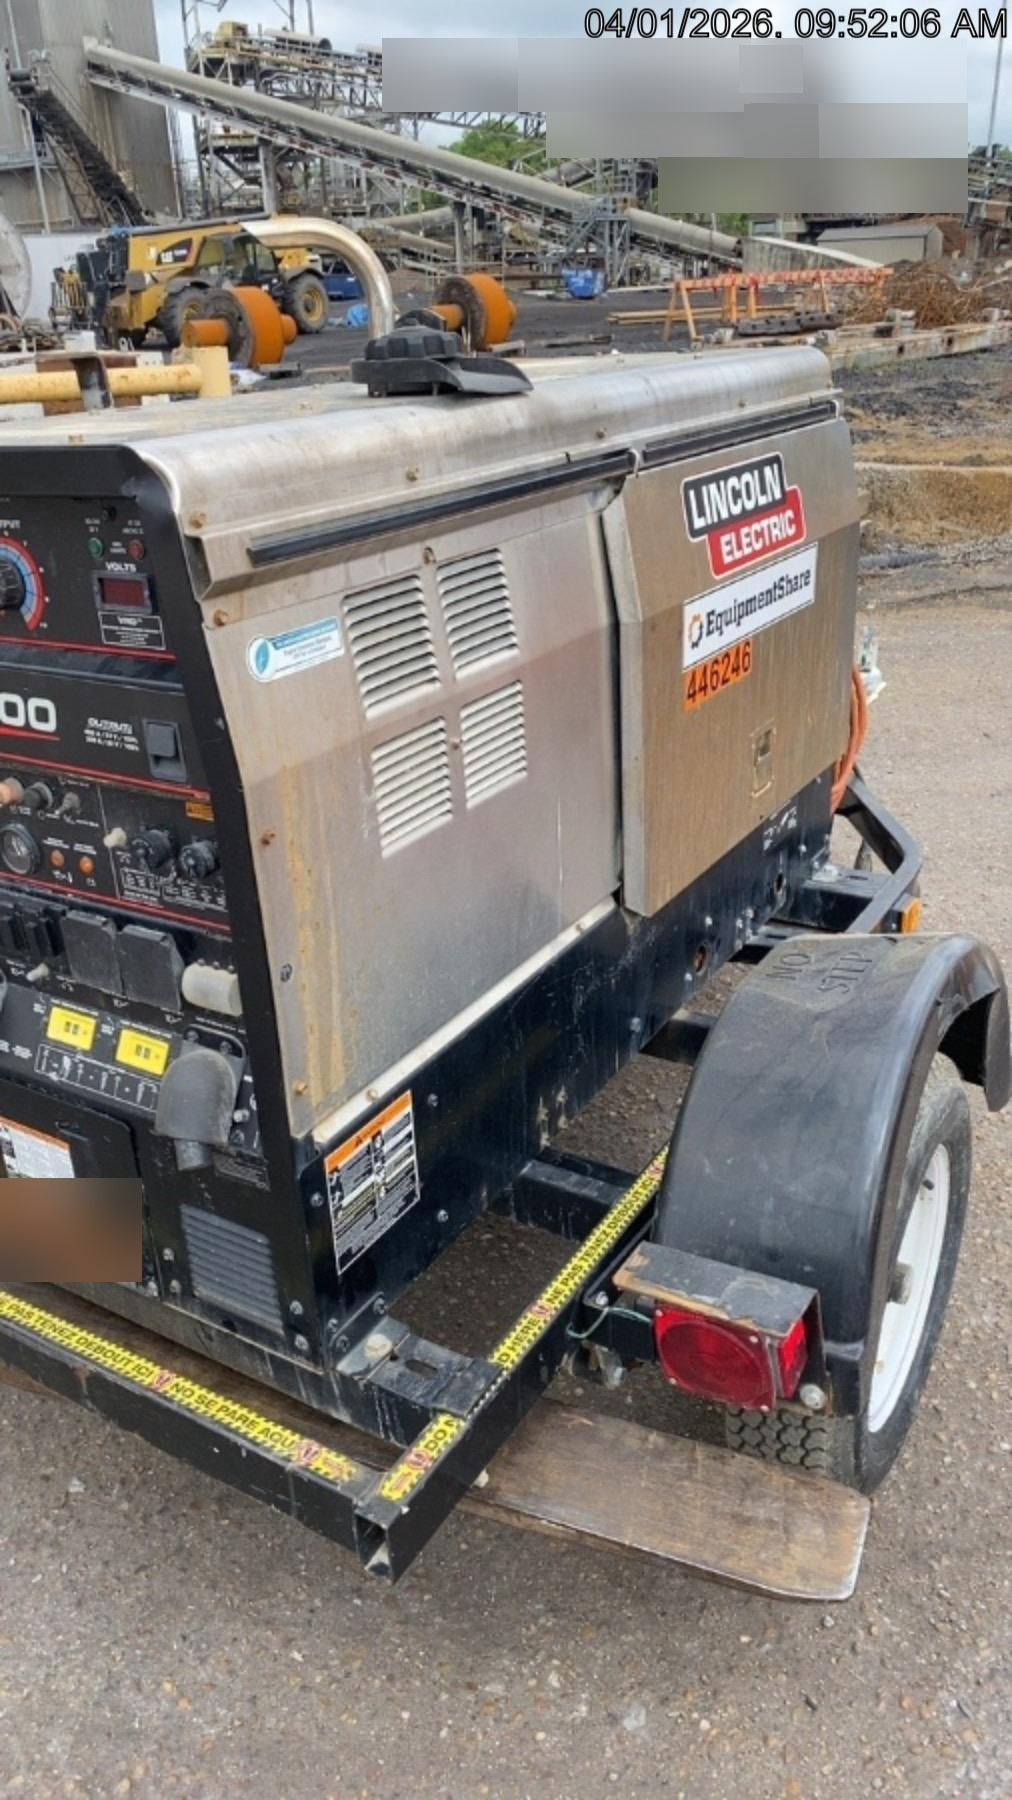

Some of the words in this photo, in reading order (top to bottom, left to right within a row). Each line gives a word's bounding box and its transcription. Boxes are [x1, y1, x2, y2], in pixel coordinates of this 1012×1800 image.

[689, 463, 783, 530] LINCOLN
[719, 509, 797, 565] ELECTRIC
[105, 561, 137, 573] VOLTS
[705, 569, 811, 638] EquipmentShare
[686, 641, 751, 704] 446246
[764, 952, 811, 981] NO
[816, 950, 873, 995] STEP
[559, 1263, 584, 1288] PAS
[34, 1315, 78, 1341] TENEZ
[75, 1336, 135, 1368] DEBOUT
[131, 1362, 155, 1380] ICI
[505, 1318, 541, 1353] HERE
[169, 1383, 195, 1399] NO
[197, 1395, 220, 1410] SE
[215, 1405, 260, 1431] PARE
